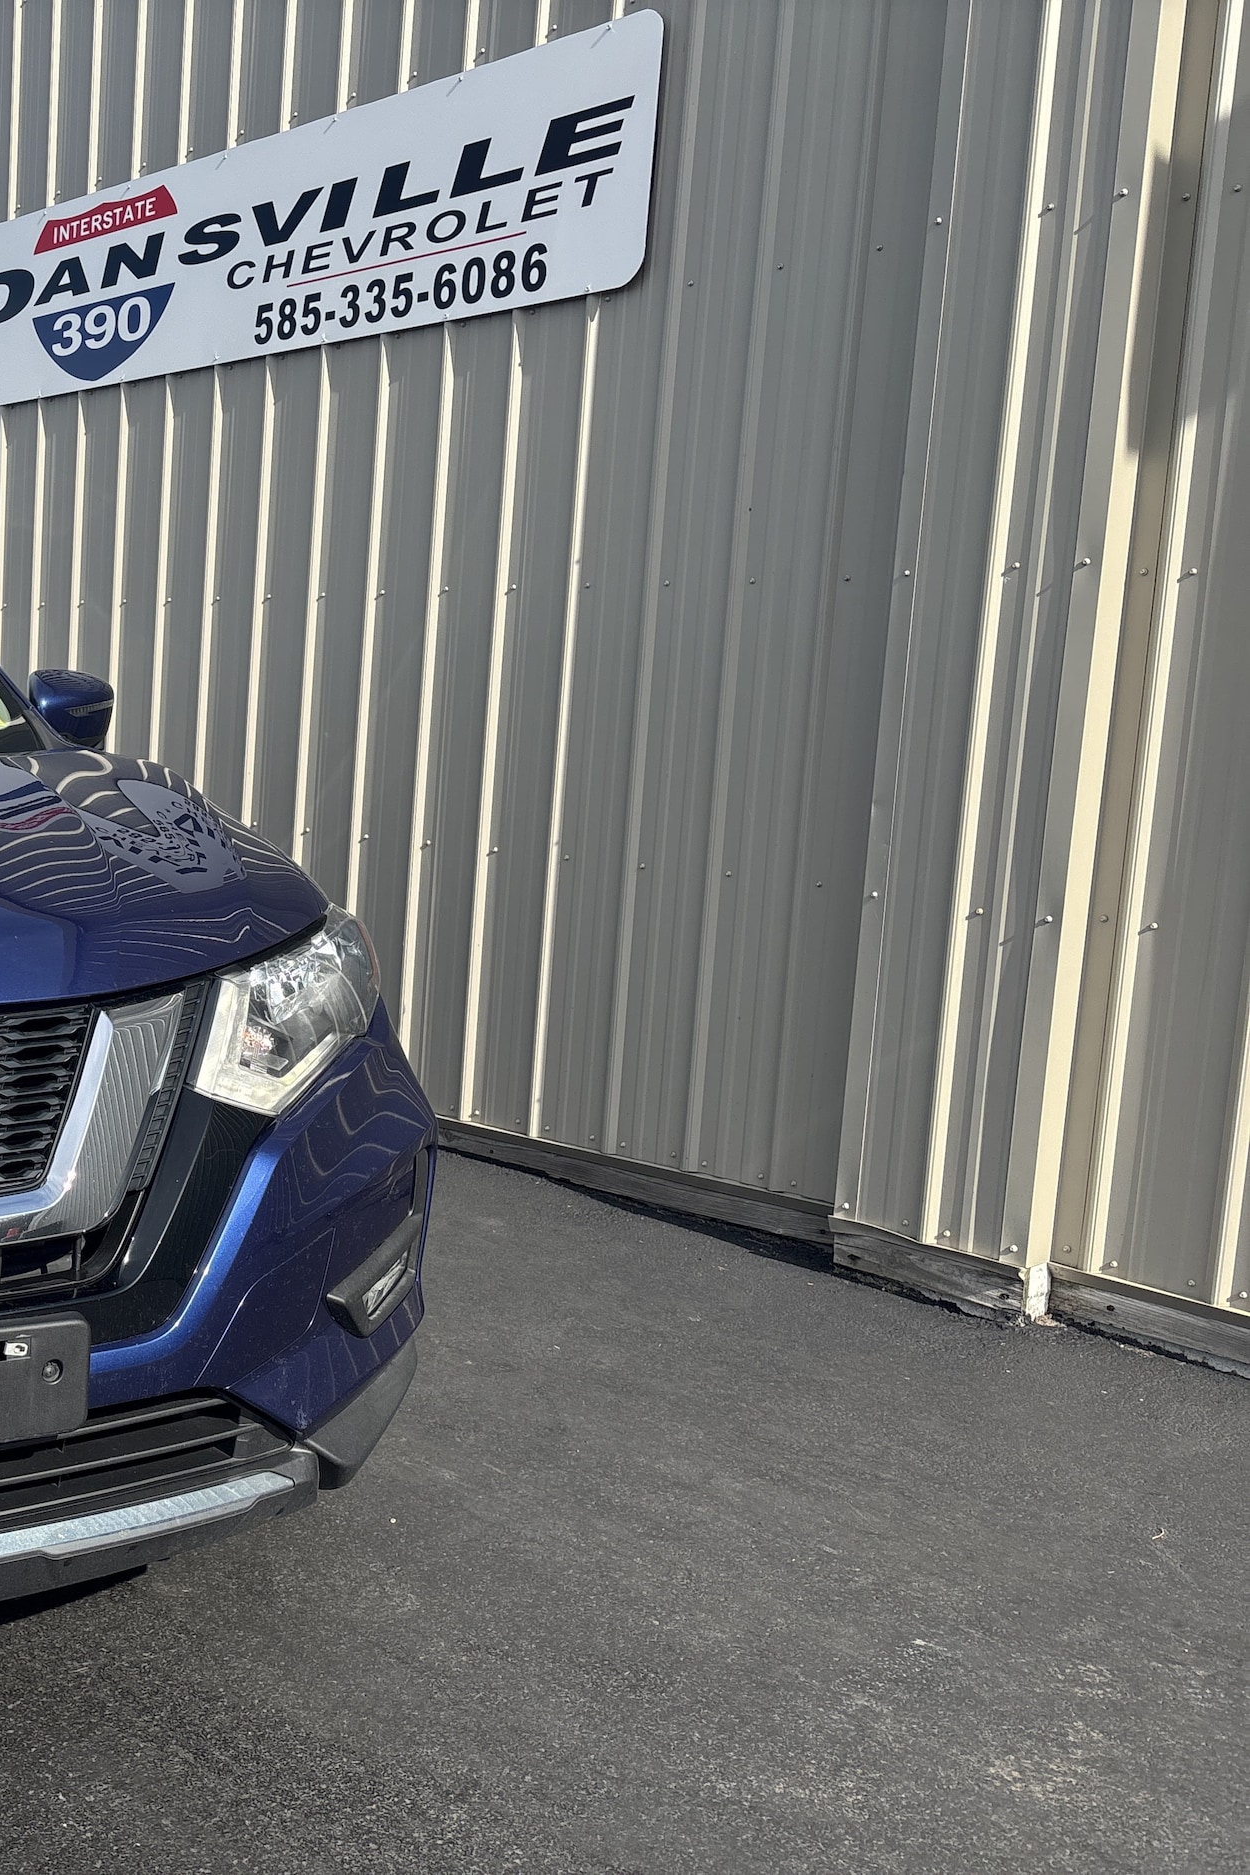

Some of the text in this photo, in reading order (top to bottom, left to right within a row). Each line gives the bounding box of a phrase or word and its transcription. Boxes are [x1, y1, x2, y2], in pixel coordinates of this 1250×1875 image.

[53, 197, 157, 245] INTERSTATE
[227, 167, 614, 290] CHEVROLET
[51, 296, 151, 357] 390
[254, 242, 548, 346] 585-335-6086
